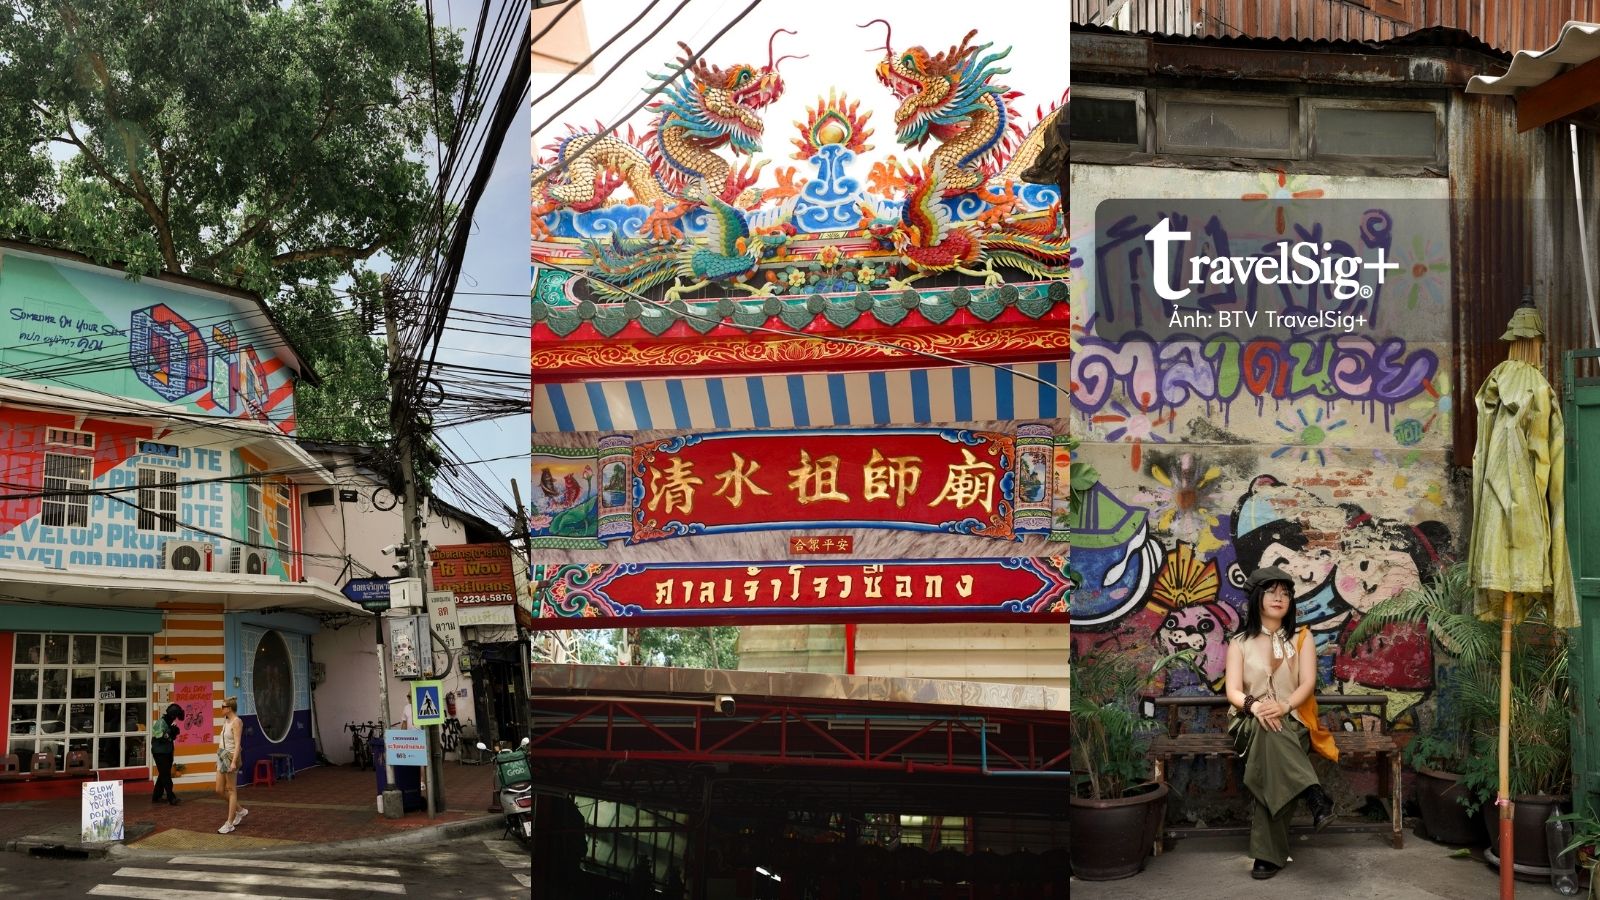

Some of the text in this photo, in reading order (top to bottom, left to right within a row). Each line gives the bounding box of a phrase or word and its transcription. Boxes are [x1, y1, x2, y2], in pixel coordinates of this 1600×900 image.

[647, 446, 999, 516] 清水祖師廟
[435, 621, 456, 632] ความ
[442, 634, 455, 647] ร็ว
[100, 691, 115, 699] OPEN
[506, 767, 525, 777] Grab
[89, 783, 114, 796] SLOW
[94, 790, 114, 801] DOWN
[89, 806, 117, 819] DOING
